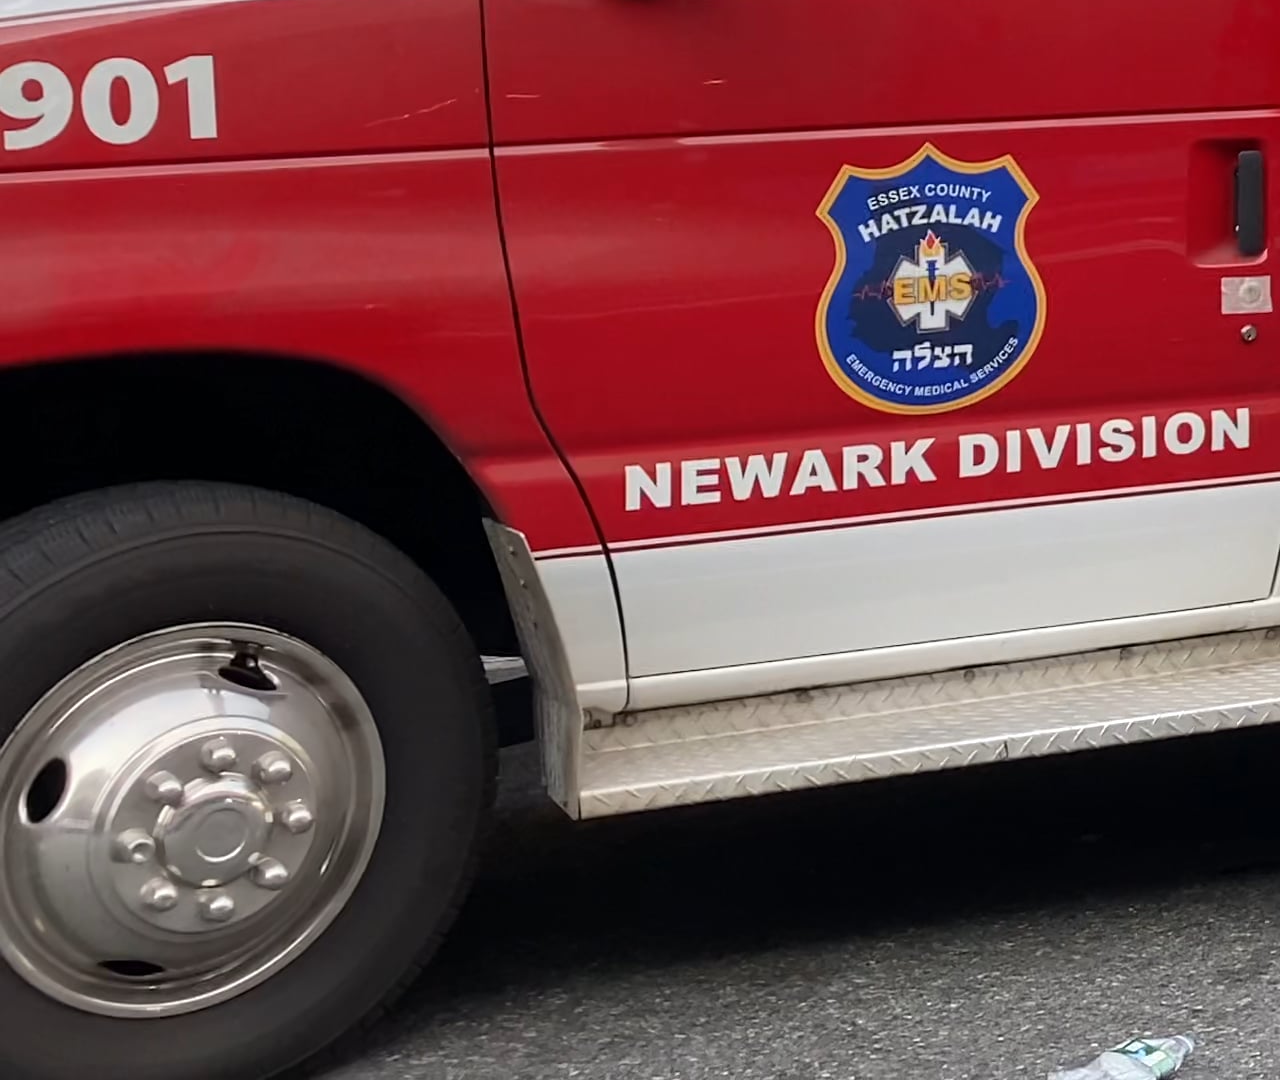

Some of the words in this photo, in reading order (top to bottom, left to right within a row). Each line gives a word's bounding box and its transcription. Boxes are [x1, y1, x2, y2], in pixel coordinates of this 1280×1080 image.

[0, 54, 218, 152] 901
[866, 185, 921, 211] ESSEX
[924, 182, 992, 204] COUNTY
[857, 203, 1003, 243] HATZALAH
[892, 272, 974, 307] EMS
[845, 352, 913, 396] EMERGENCY
[913, 378, 969, 397] MEDICAL
[968, 336, 1019, 385] SERVICES
[624, 437, 937, 512] NEWARK
[957, 406, 1251, 479] DIVISION
